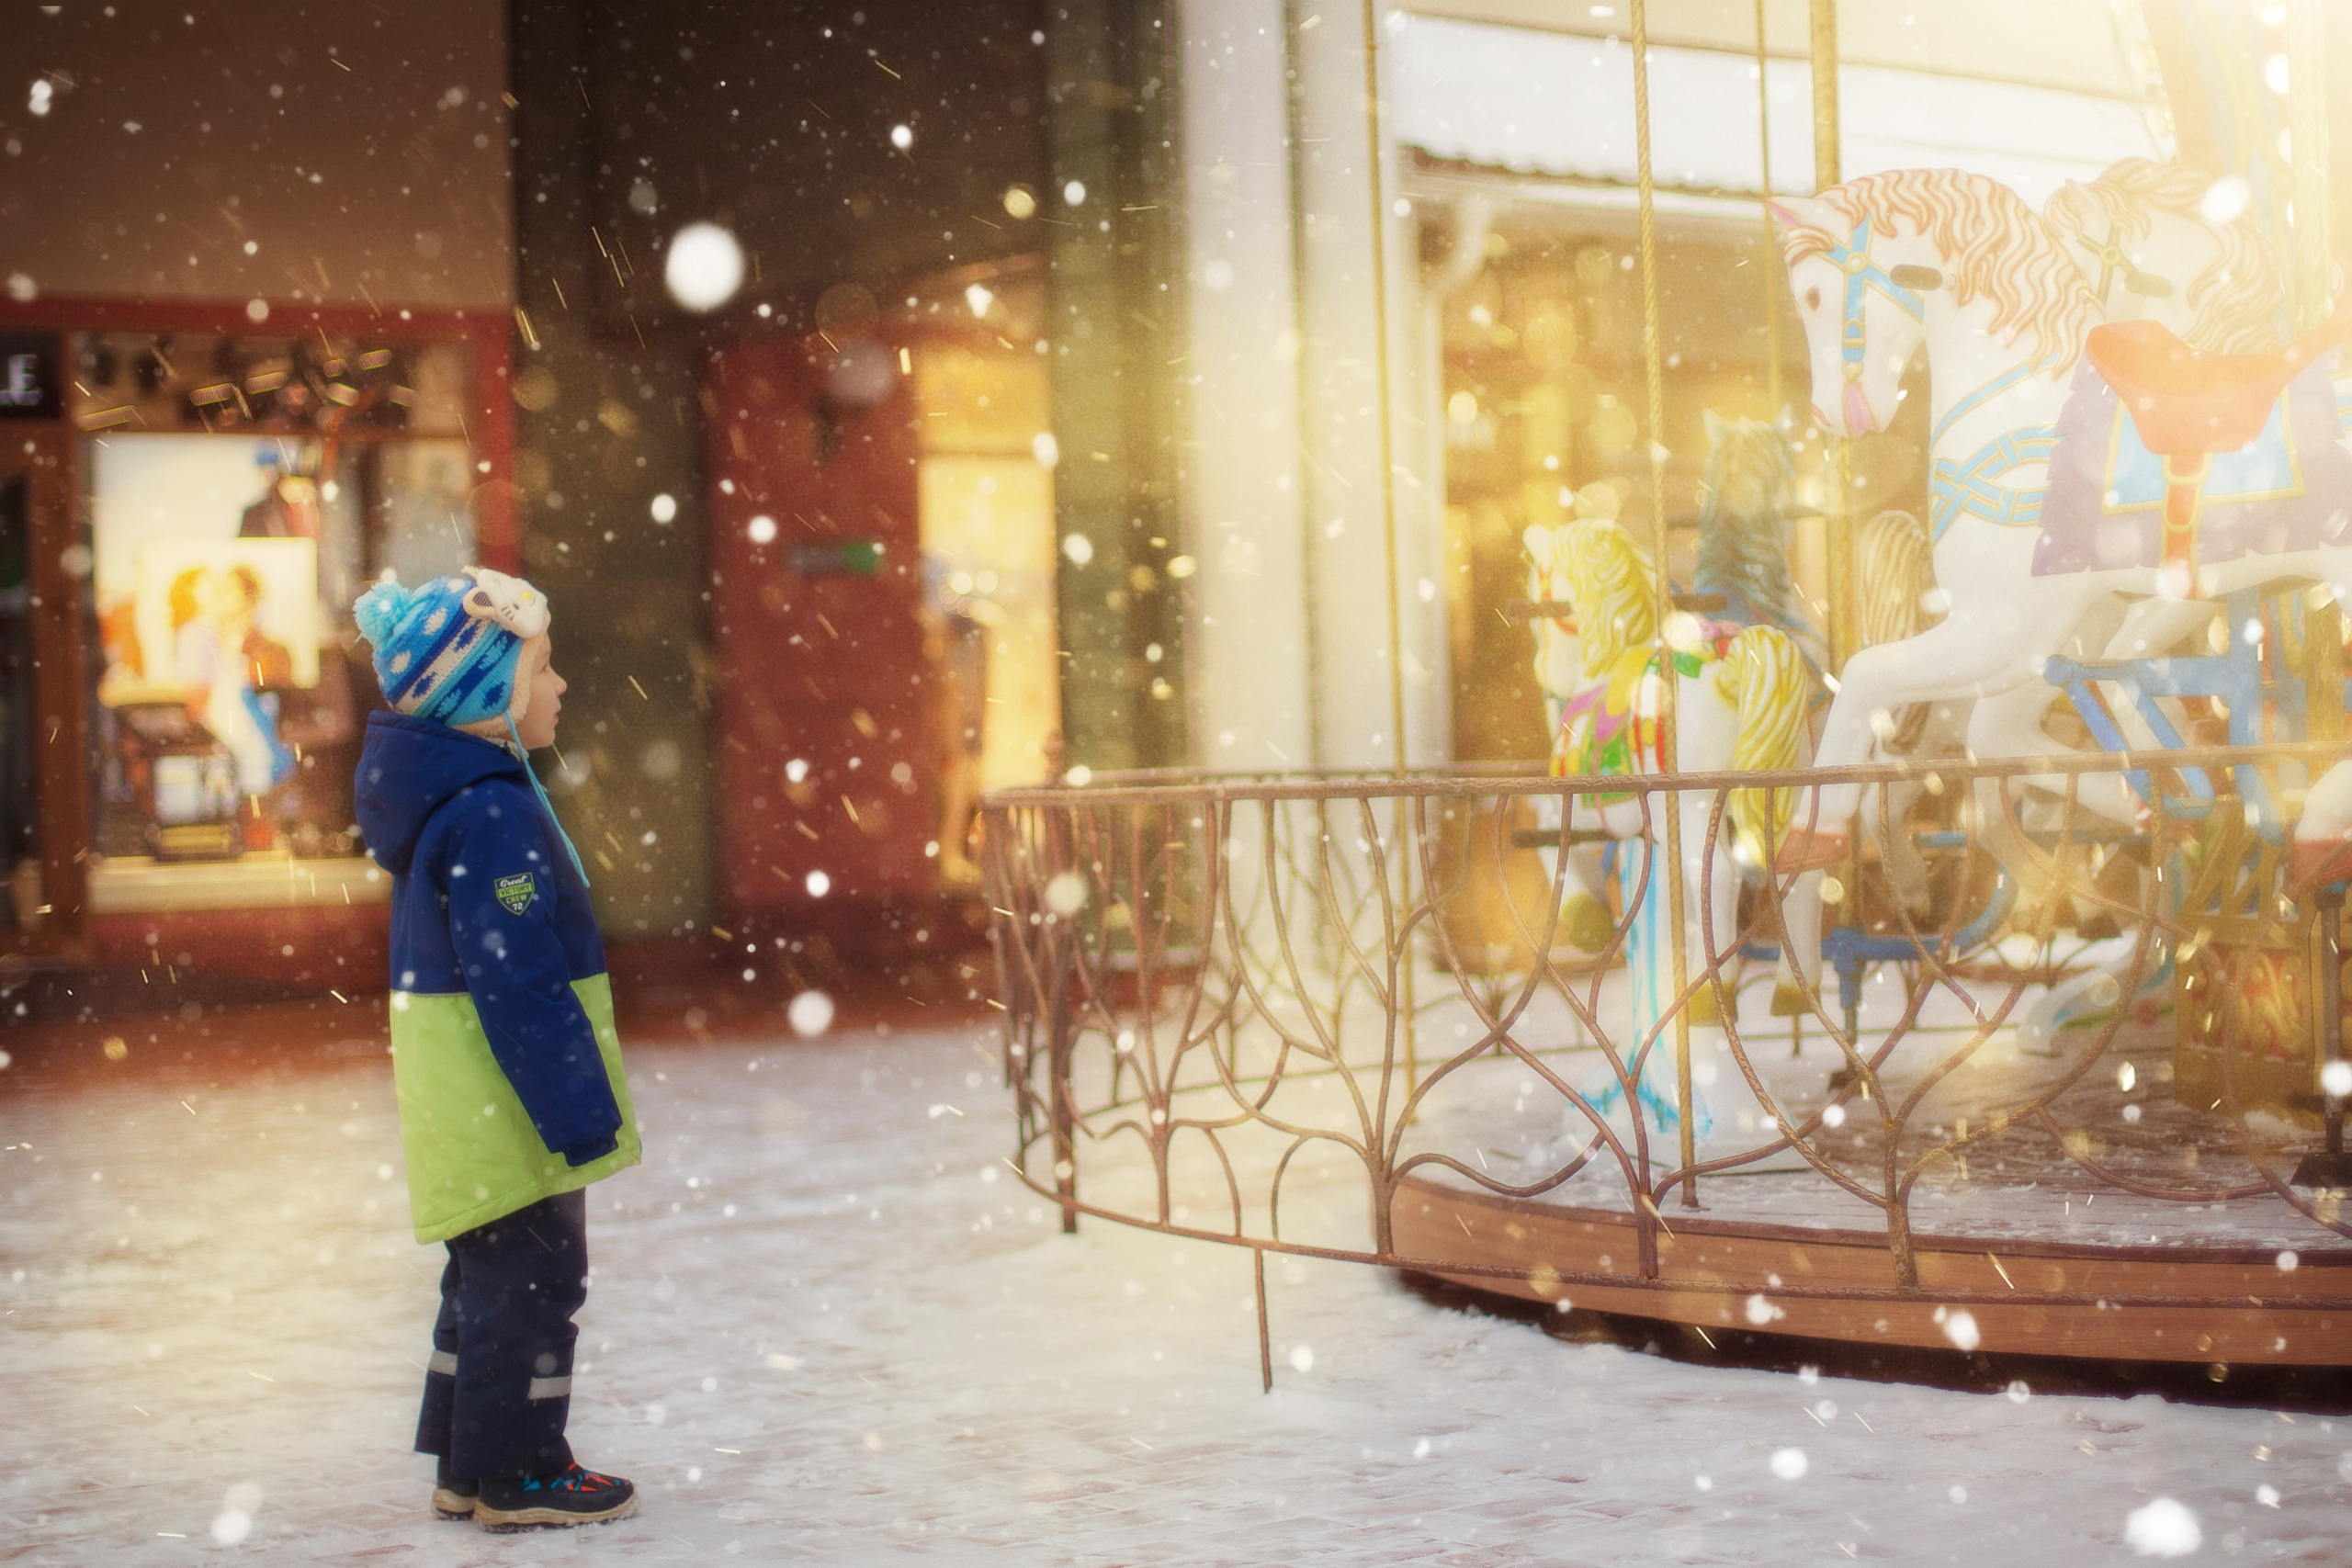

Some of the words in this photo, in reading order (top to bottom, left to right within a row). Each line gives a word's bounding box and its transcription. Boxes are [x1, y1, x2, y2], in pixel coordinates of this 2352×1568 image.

[0, 354, 42, 406] E
[499, 874, 528, 888] Great
[500, 884, 531, 897] VICTORY
[505, 894, 527, 905] CREW
